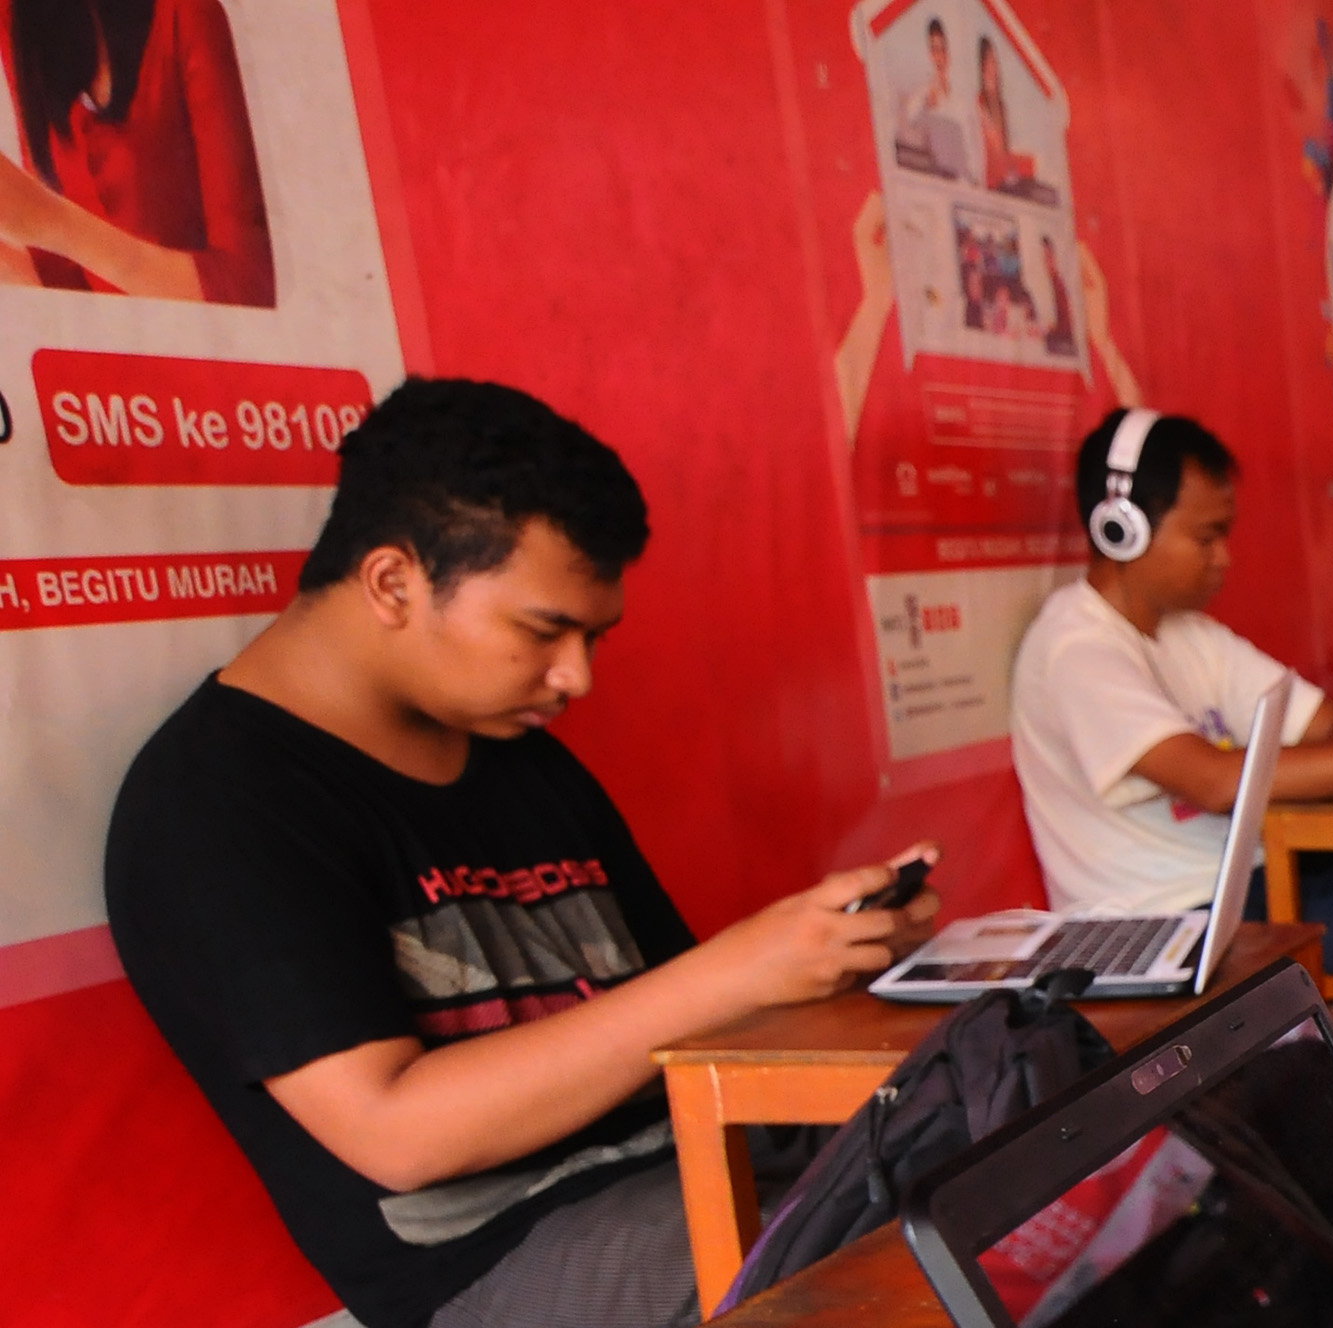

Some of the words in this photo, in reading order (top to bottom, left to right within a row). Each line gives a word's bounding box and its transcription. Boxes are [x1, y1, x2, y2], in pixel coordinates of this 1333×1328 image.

[52, 390, 165, 447] SMS
[173, 397, 230, 449] ke
[37, 568, 160, 607] BEGITU
[167, 563, 278, 600] MURAH
